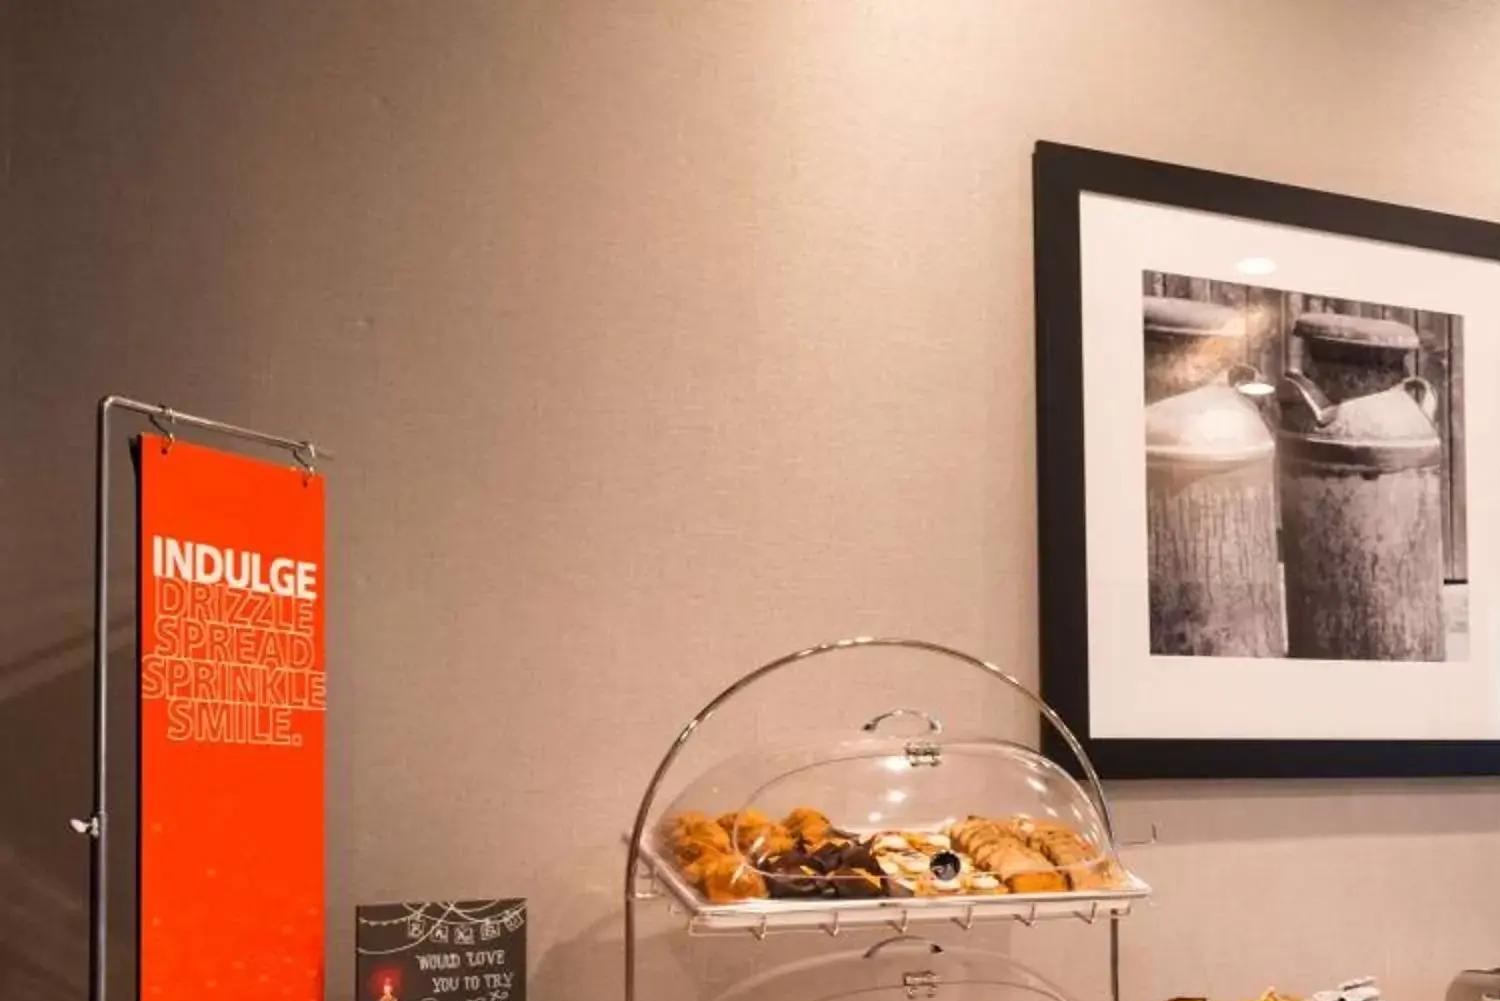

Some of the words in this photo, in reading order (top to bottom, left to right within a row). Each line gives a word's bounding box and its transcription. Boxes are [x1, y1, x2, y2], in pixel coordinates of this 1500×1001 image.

[153, 534, 317, 600] INDULGE
[155, 575, 313, 637] DRIZZLE
[154, 616, 316, 670] SPREAD
[141, 653, 328, 711] SPRINKLE
[166, 699, 303, 747] SMILE.
[415, 953, 461, 970] WOULD
[465, 949, 505, 967] LOVE
[432, 976, 459, 992] YOU
[464, 975, 480, 990] TO
[483, 971, 515, 989] TRY
